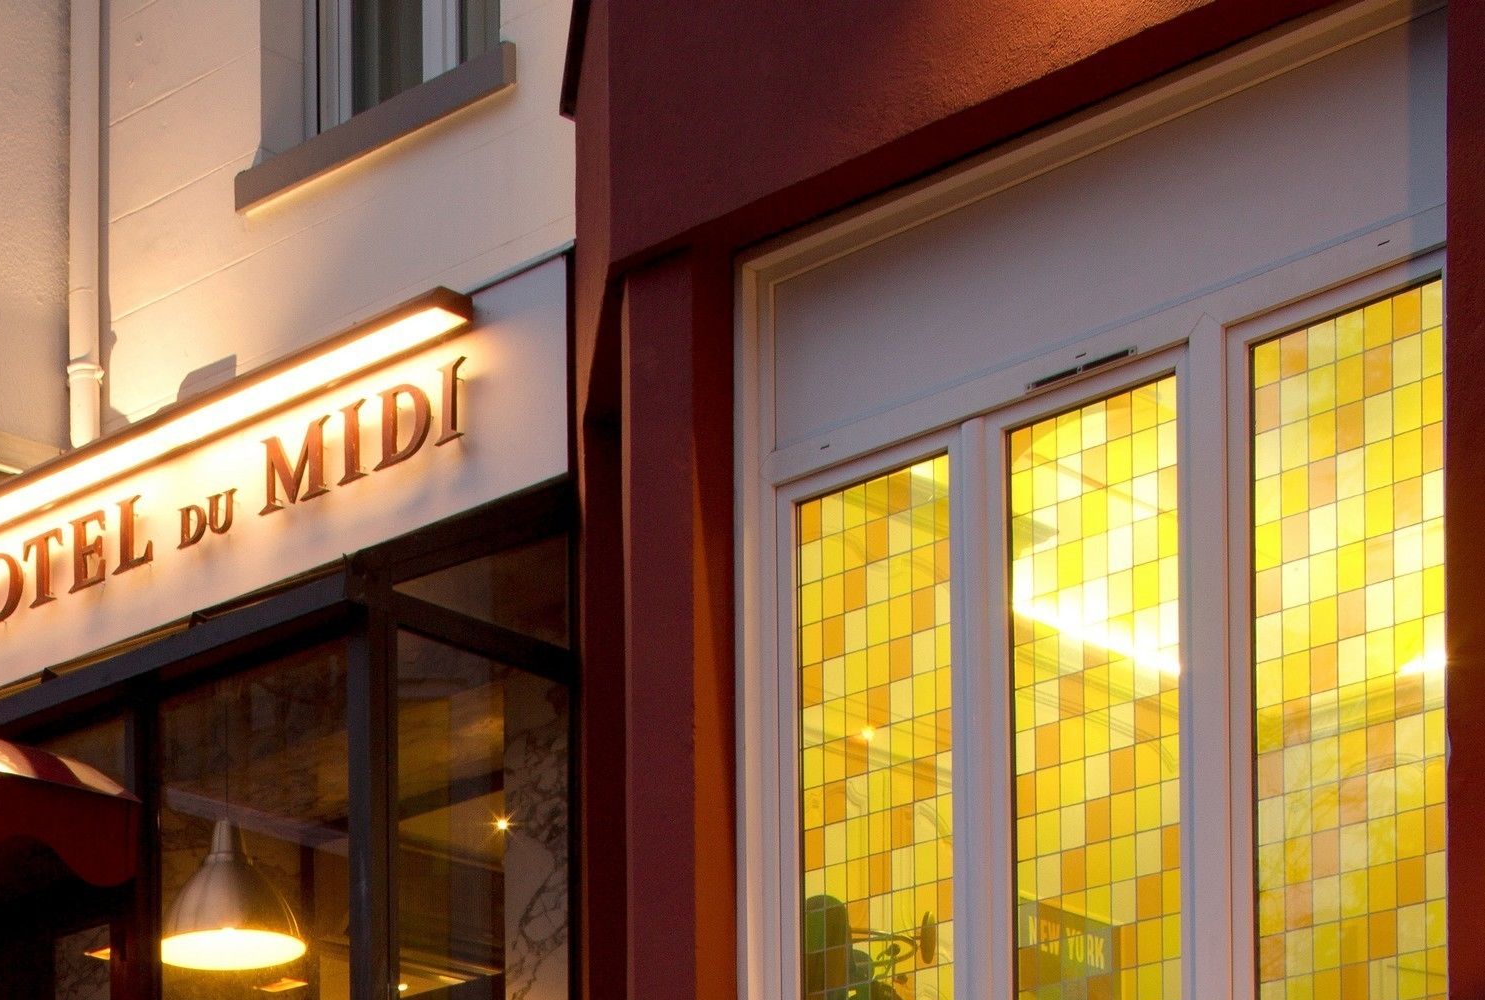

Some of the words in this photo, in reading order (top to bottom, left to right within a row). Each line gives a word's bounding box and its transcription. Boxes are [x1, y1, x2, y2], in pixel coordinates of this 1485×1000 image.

[177, 488, 237, 550] DU
[258, 356, 467, 516] MIDI
[1029, 915, 1060, 956] NEW
[1066, 927, 1105, 970] YORK
